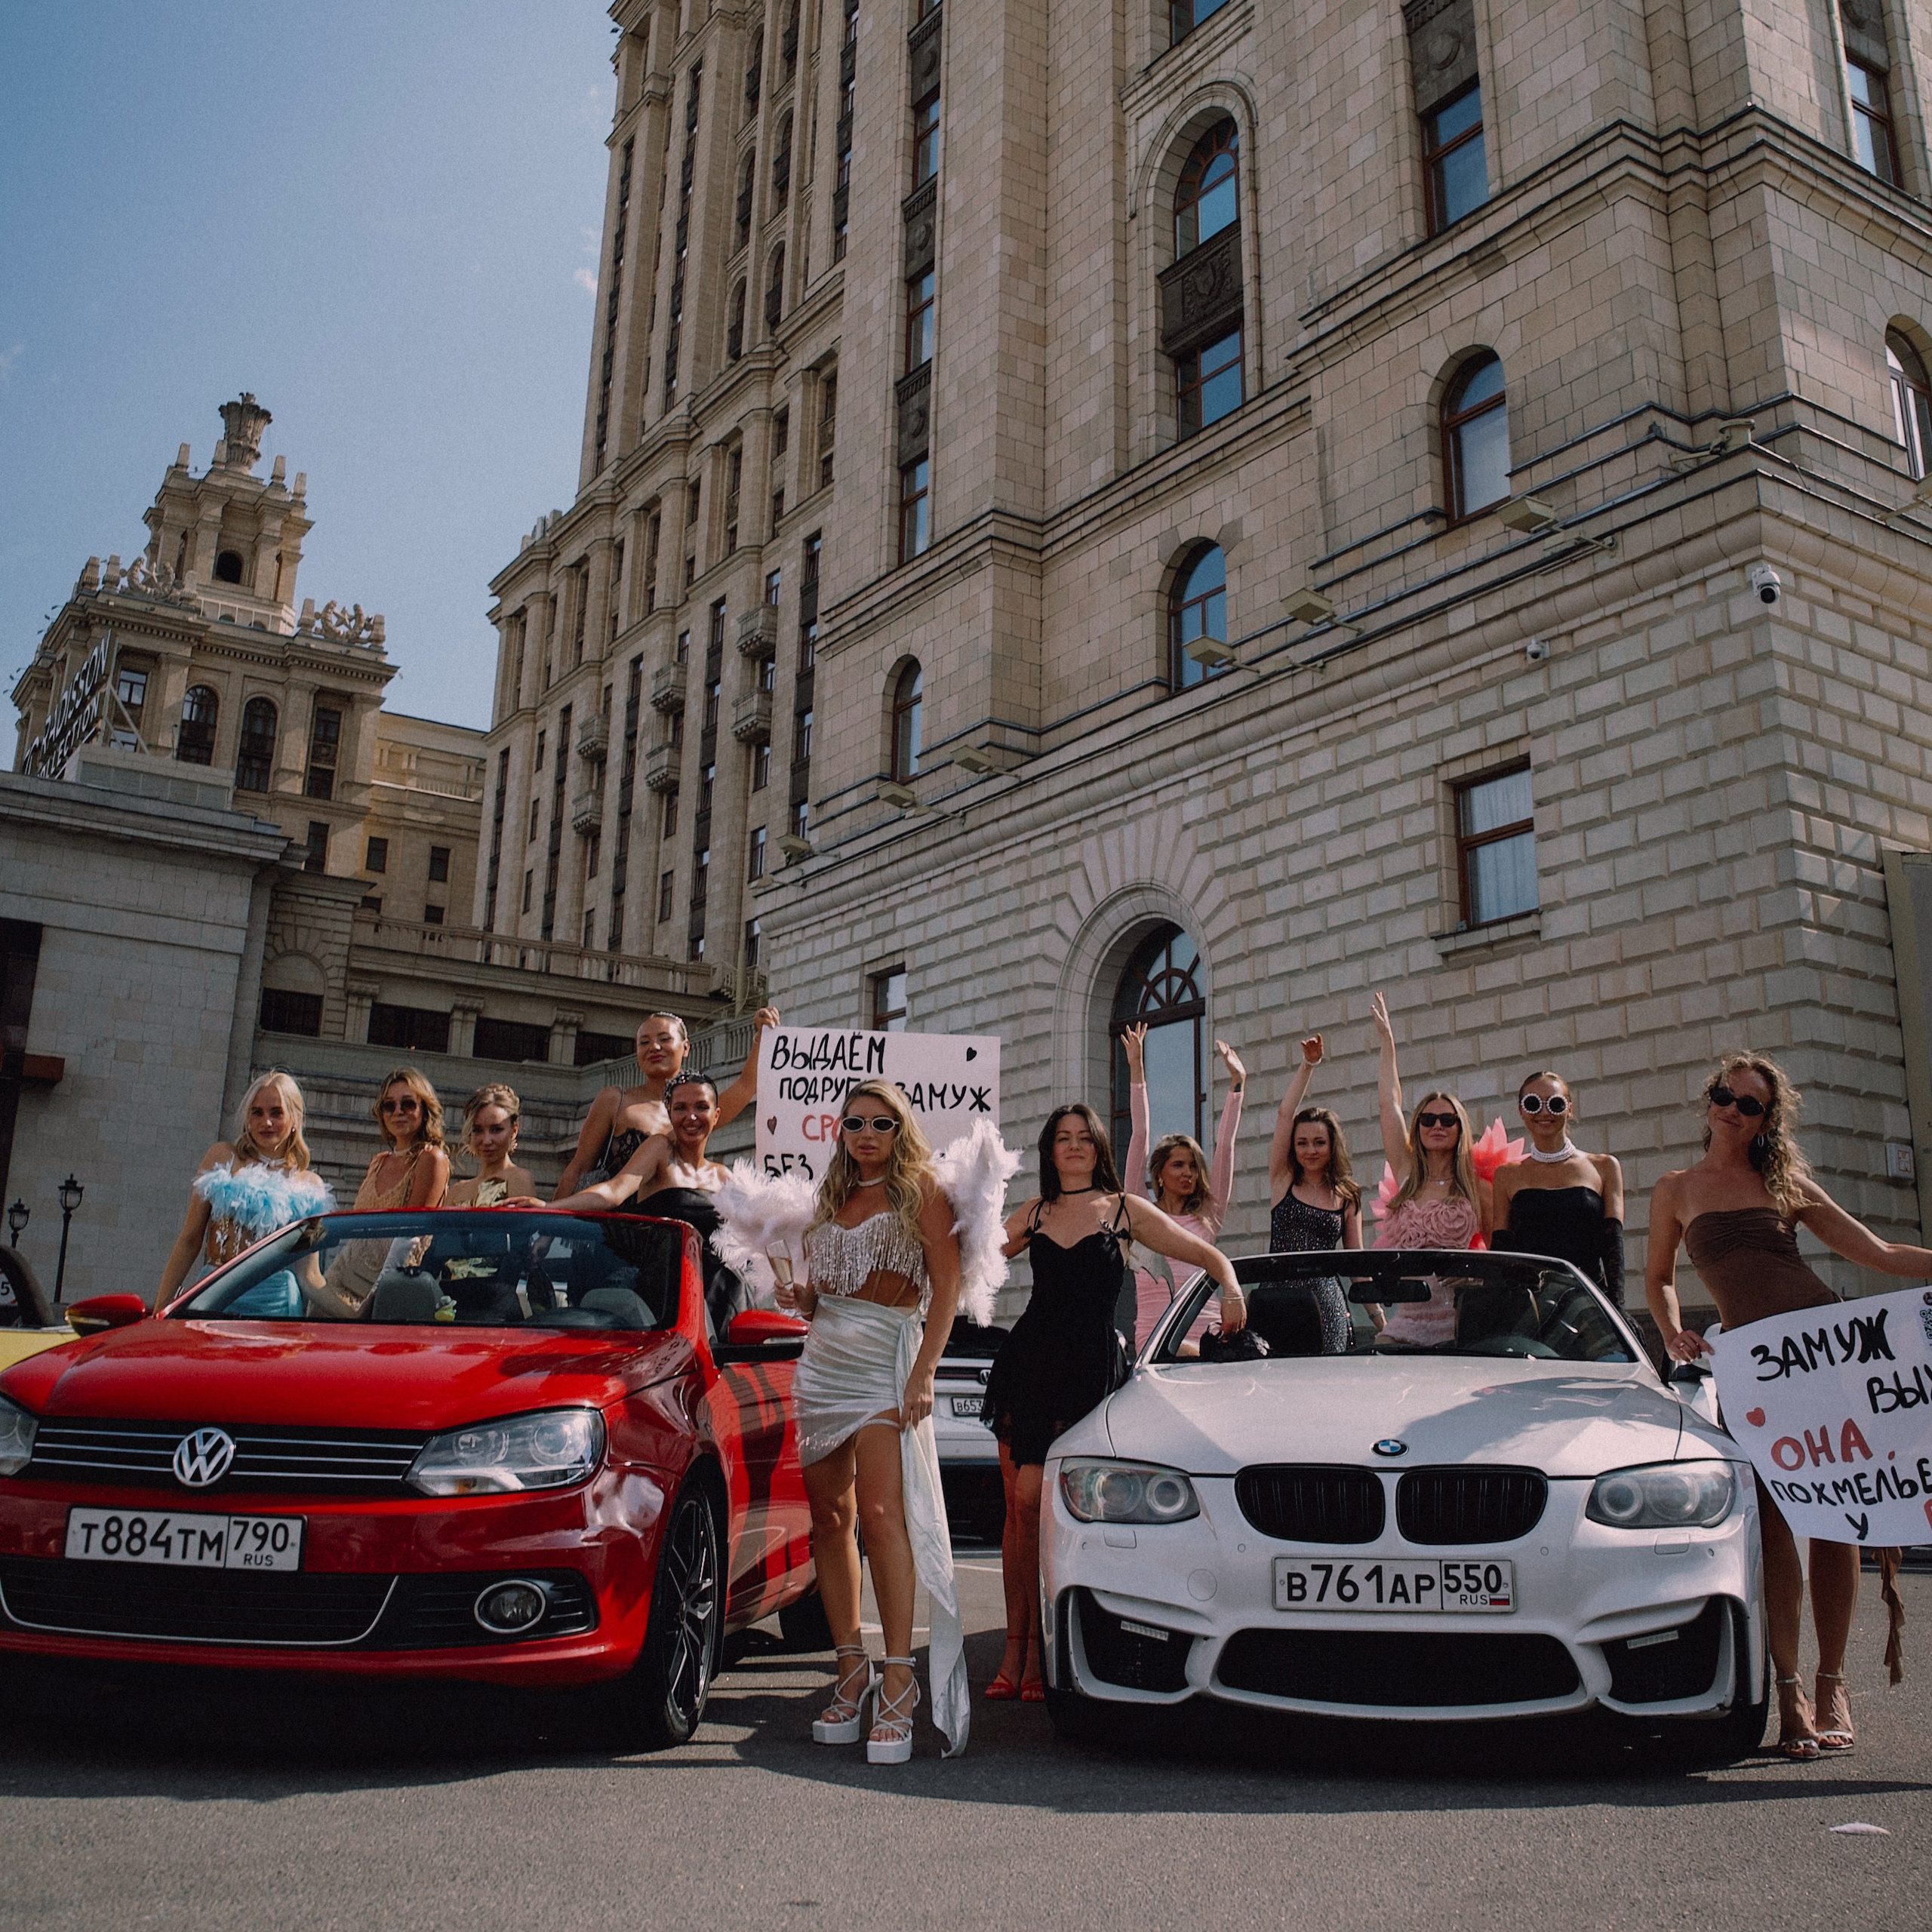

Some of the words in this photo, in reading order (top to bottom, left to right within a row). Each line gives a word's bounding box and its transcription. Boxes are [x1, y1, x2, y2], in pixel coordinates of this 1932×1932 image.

[40, 629, 112, 758] RADISSON
[770, 1031, 886, 1074] ВЫДАЁМ
[780, 1077, 860, 1105] ПОДРУГ
[1751, 1308, 1896, 1381] ЗАМУЖ
[1866, 1364, 1932, 1414] ВЫ
[956, 1400, 983, 1411] В653
[232, 1520, 290, 1552] 790
[1845, 1512, 1869, 1540] У
[243, 1553, 274, 1567] RUS
[1444, 1564, 1502, 1594] 550
[1460, 1594, 1488, 1605] RUS
